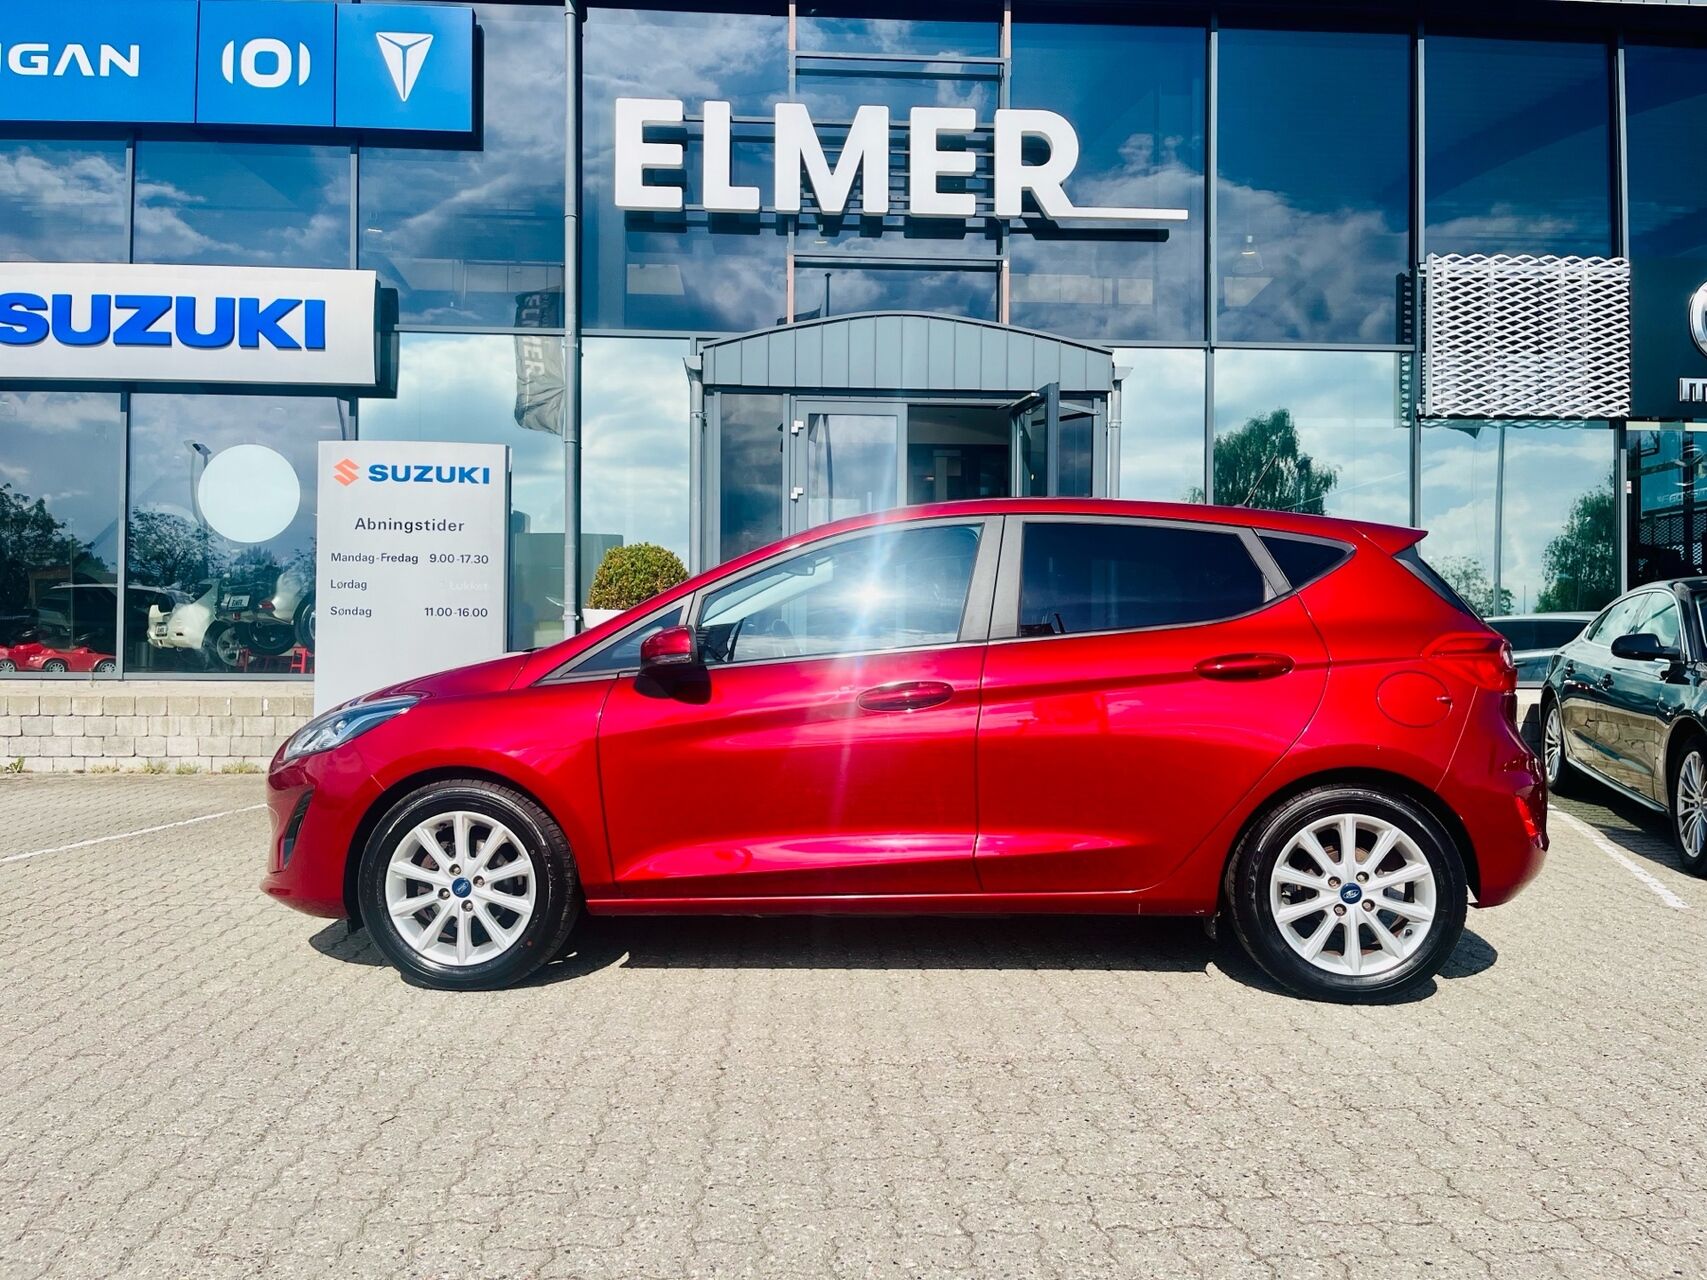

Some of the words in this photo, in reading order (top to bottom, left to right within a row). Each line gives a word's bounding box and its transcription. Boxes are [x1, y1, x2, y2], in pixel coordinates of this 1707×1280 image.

[614, 97, 1189, 220] ELMER
[0, 292, 326, 350] SUZUKI
[368, 464, 490, 485] SUZUKI
[330, 553, 419, 565] Mandag-Fredag
